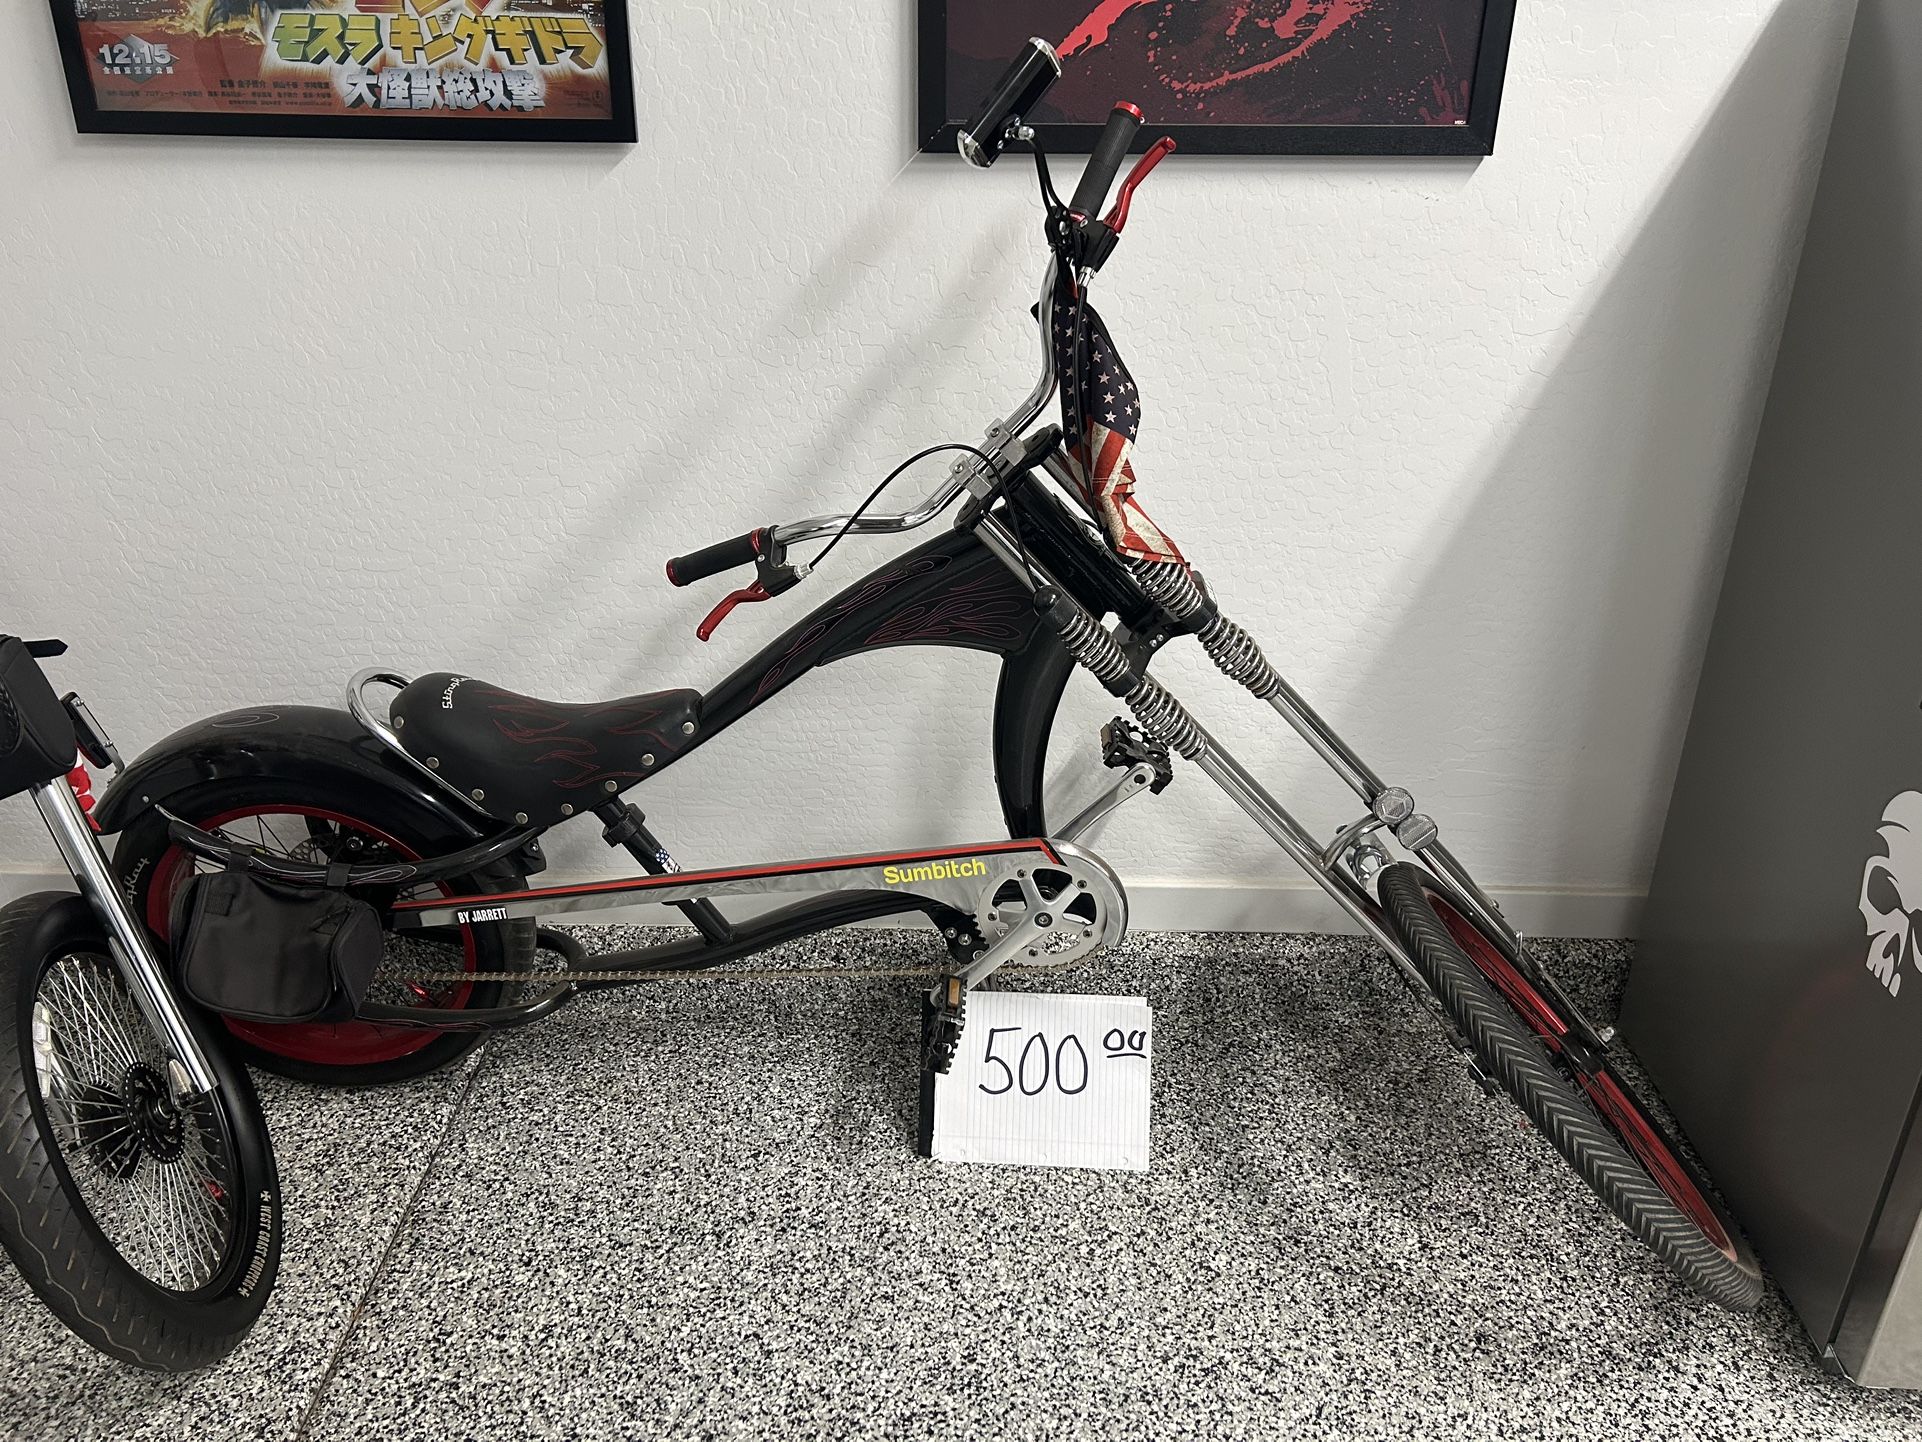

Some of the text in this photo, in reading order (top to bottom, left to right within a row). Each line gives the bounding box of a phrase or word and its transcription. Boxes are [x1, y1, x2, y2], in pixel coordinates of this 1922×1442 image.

[99, 44, 171, 64] 12.15
[272, 13, 604, 70] モスラ キングギドラ
[343, 66, 546, 111] 大怪獣総攻撃
[883, 858, 986, 884] Sumbitch
[457, 907, 507, 924] BY JARRETT
[979, 1027, 1088, 1096] 500
[242, 1205, 272, 1291] WEST COAST CHOPPERS
